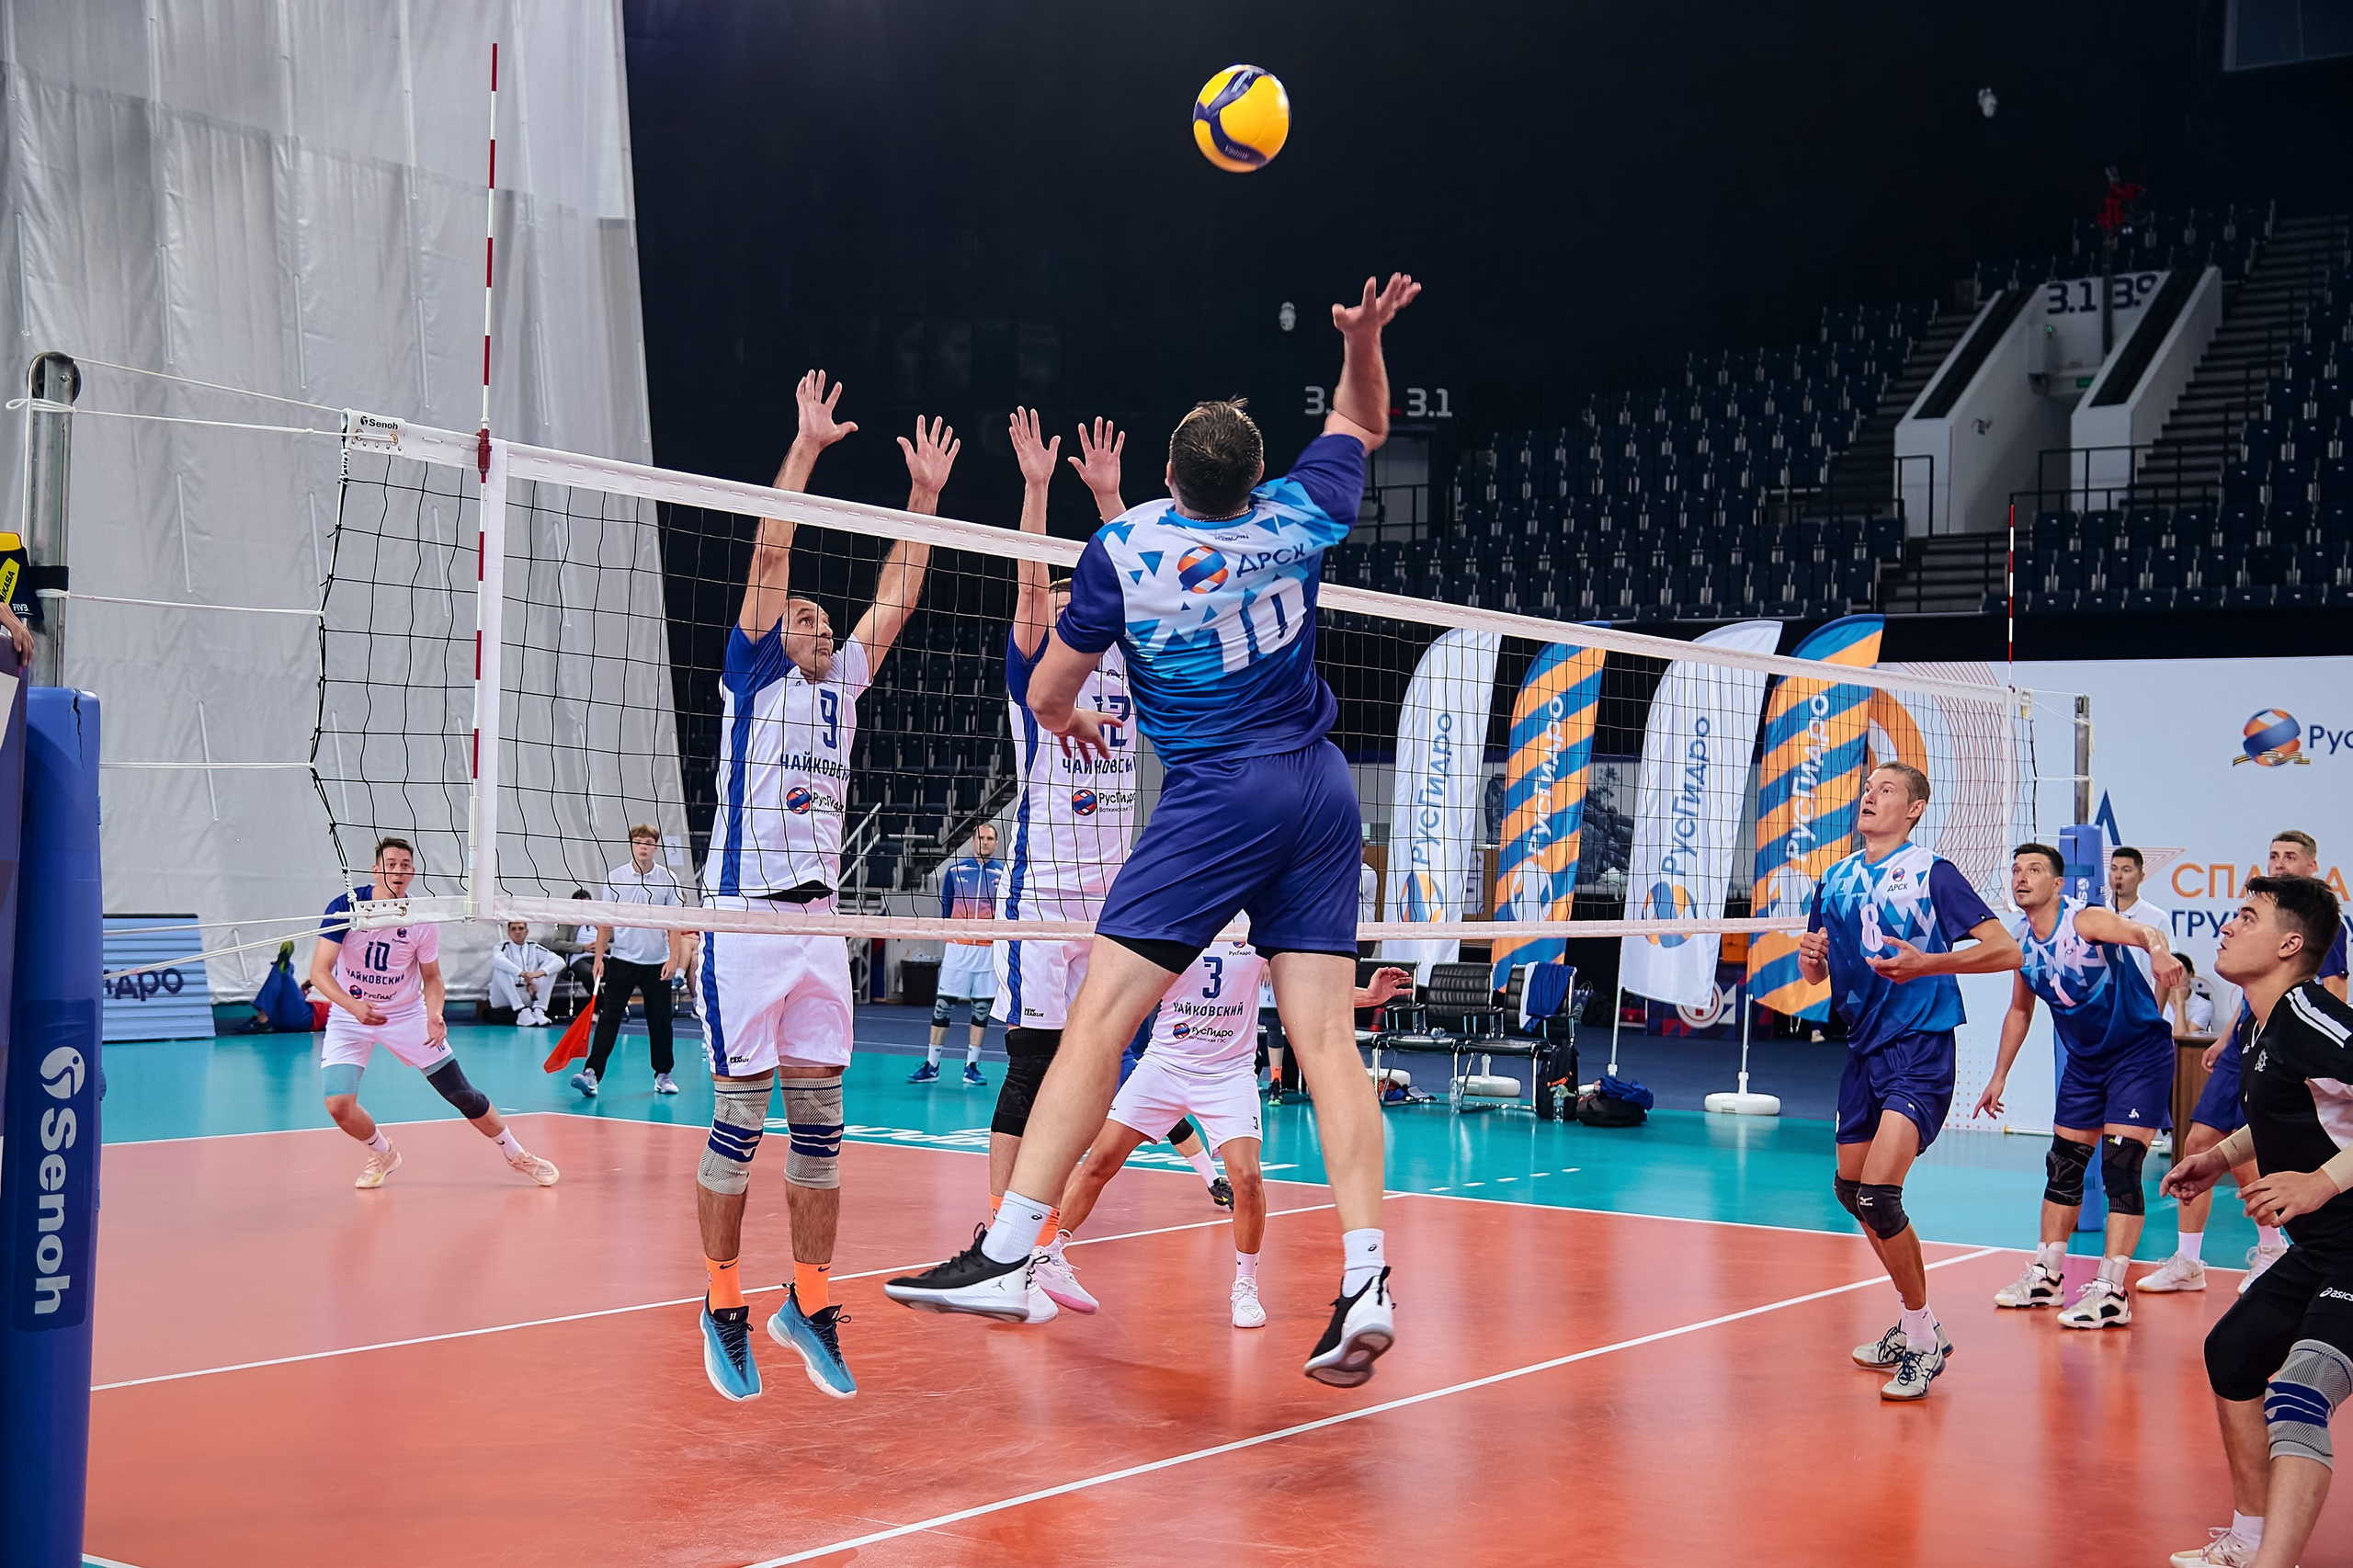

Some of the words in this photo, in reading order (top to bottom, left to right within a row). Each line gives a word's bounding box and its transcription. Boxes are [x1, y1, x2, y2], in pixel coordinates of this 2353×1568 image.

[2047, 281, 2097, 315] 3.1
[1304, 385, 1334, 415] 3.
[1406, 387, 1454, 417] 3.1
[369, 418, 399, 430] Senoh
[1236, 542, 1306, 578] ДРСК
[1199, 576, 1308, 674] 10
[818, 687, 838, 750] 9
[1091, 694, 1131, 748] 12
[1412, 711, 1453, 866] РусГидро
[1528, 696, 1564, 857] РусГидро
[1786, 692, 1830, 862] РусГидро
[1660, 715, 1711, 877] РусГидро
[1887, 882, 1909, 892] ДРСК
[2172, 862, 2351, 902] СПАА
[1860, 903, 1884, 952] 8
[2172, 908, 2237, 938] ГРУ
[364, 940, 391, 971] 10
[1201, 956, 1223, 999] 3
[2049, 971, 2077, 1007] 1
[1172, 1001, 1245, 1017] ЧАЙКОВСКИЙ
[1191, 1026, 1234, 1039] РусГидро
[1252, 1115, 1259, 1131] 3
[34, 1107, 77, 1315] Senoh
